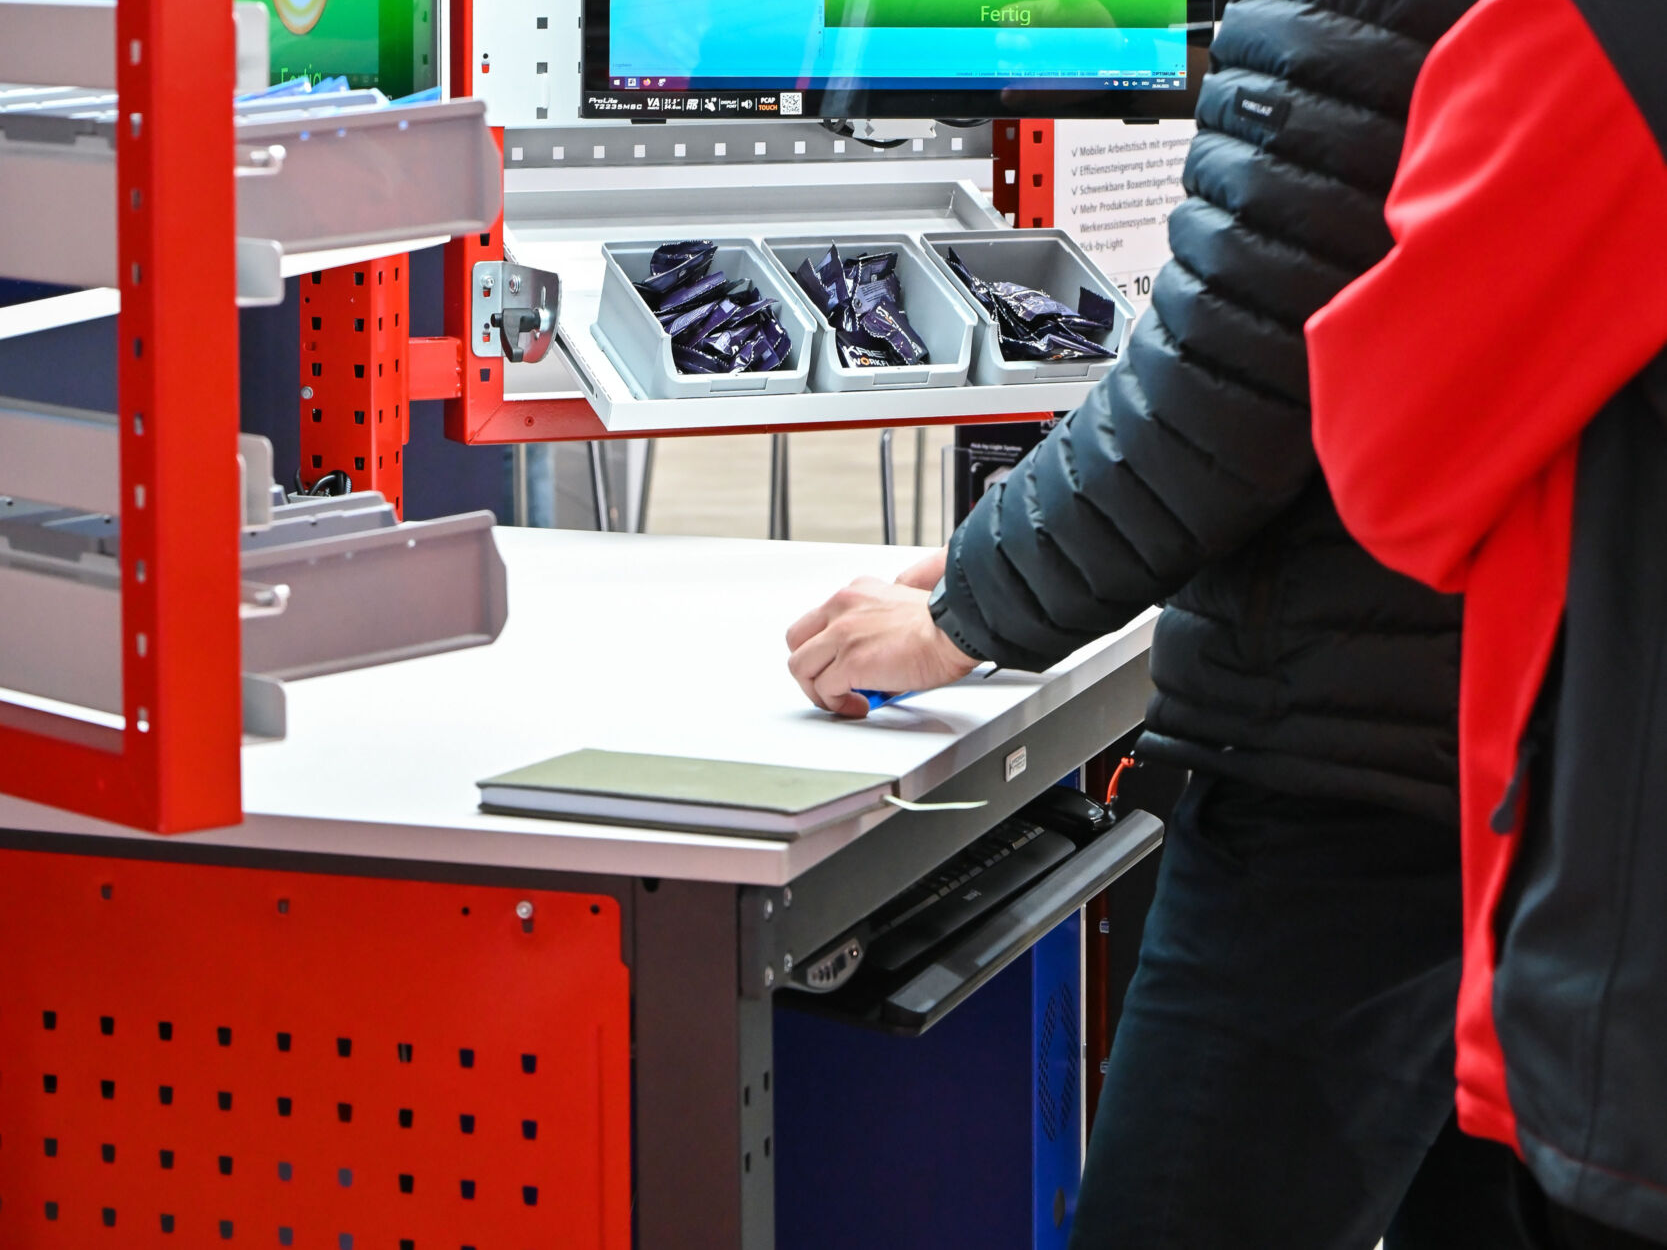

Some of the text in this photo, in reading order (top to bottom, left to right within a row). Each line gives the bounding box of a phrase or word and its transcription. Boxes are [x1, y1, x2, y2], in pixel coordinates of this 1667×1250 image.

[981, 6, 1030, 26] Fertig
[647, 98, 660, 106] VA
[1080, 146, 1106, 156] Mobiler
[1108, 141, 1147, 153] Arbeitstisch
[1149, 140, 1160, 149] mit
[1080, 161, 1144, 176] Effizienzsteigerung
[1145, 159, 1164, 169] durch
[1080, 182, 1124, 195] Schwenkbare
[1080, 204, 1097, 214] Mehr
[1100, 199, 1144, 211] Produktivität
[1145, 196, 1163, 207] durch
[1080, 216, 1156, 233] Werkerassistenzsystem
